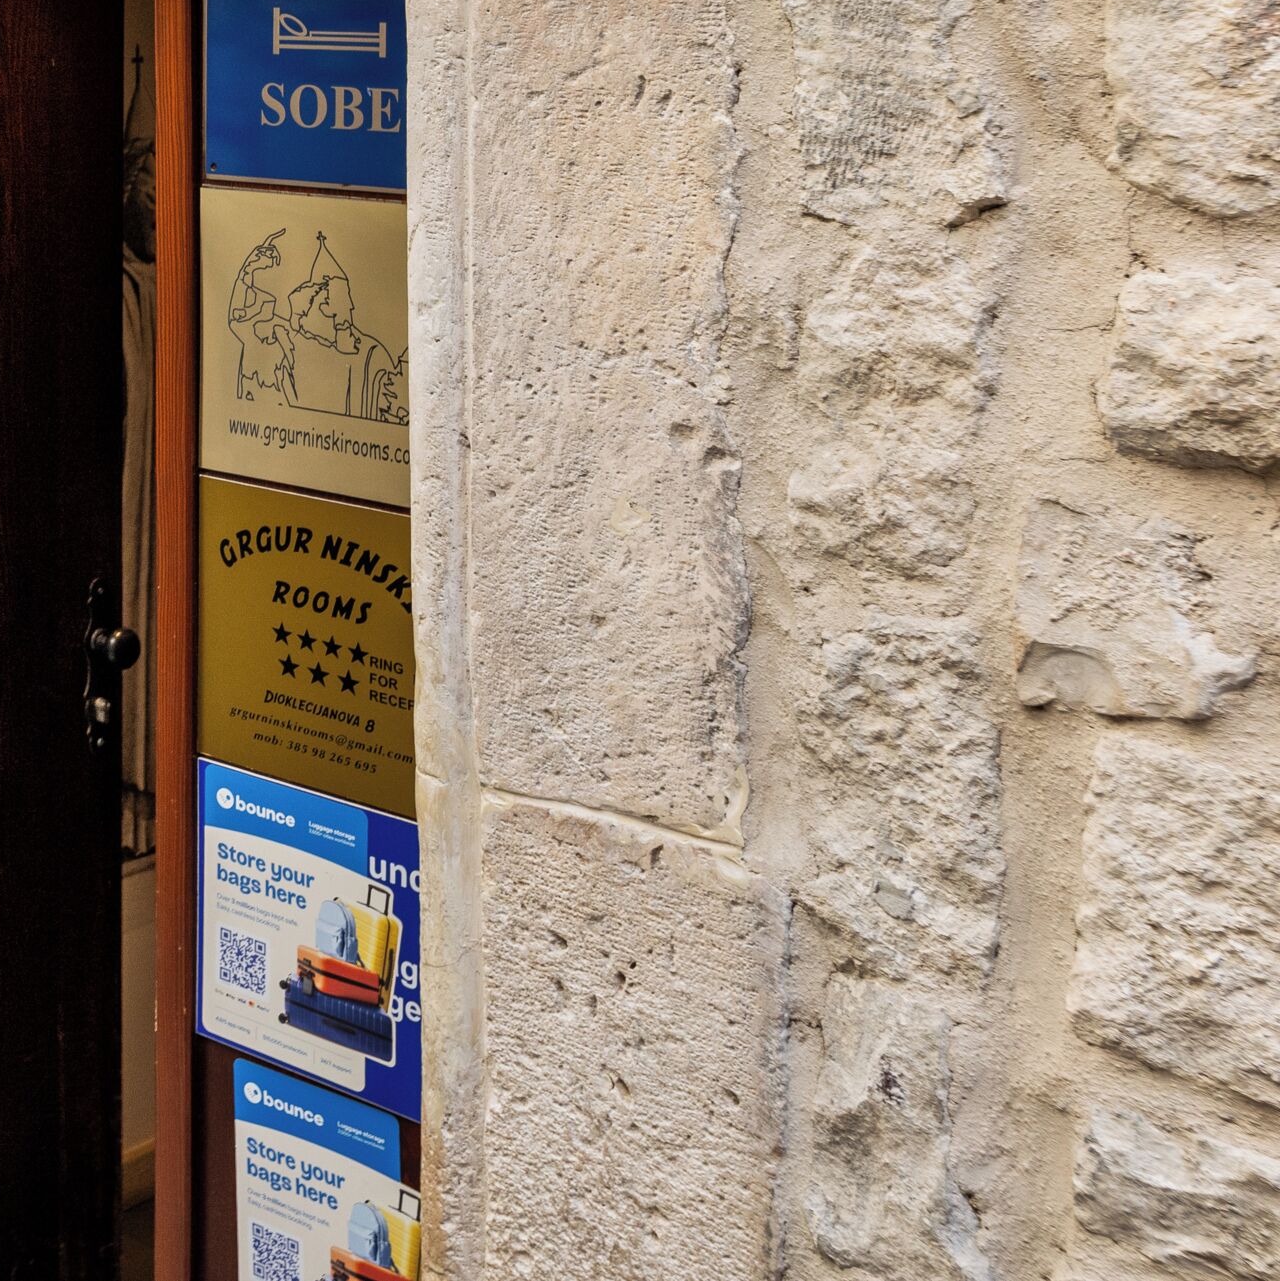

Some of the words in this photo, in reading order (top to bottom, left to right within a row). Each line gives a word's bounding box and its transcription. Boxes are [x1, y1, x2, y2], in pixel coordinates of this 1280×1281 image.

[261, 82, 401, 133] SOBE
[229, 418, 411, 465] www.grgurninskirooms.co
[219, 526, 313, 568] GRGUR
[272, 580, 372, 624] ROOMS
[369, 656, 404, 675] RING
[369, 672, 398, 690] FOR
[264, 689, 360, 728] DIOKLECIJANOVA
[365, 719, 376, 733] 8
[369, 689, 415, 711] RECEP
[229, 706, 414, 764] grgurninskirooms@gmail.com
[253, 731, 283, 747] mob:
[287, 740, 308, 754] 385
[311, 746, 326, 760] 98
[329, 752, 351, 766] 265
[354, 760, 377, 774] 695
[235, 794, 296, 828] bounce
[216, 864, 261, 895] bags
[265, 880, 307, 910] here
[217, 842, 266, 872] Store
[271, 862, 315, 889] your
[263, 1090, 324, 1127] bounce
[246, 1136, 296, 1170] Store
[300, 1160, 345, 1189] your
[247, 1158, 292, 1191] bags
[295, 1178, 338, 1210] here
